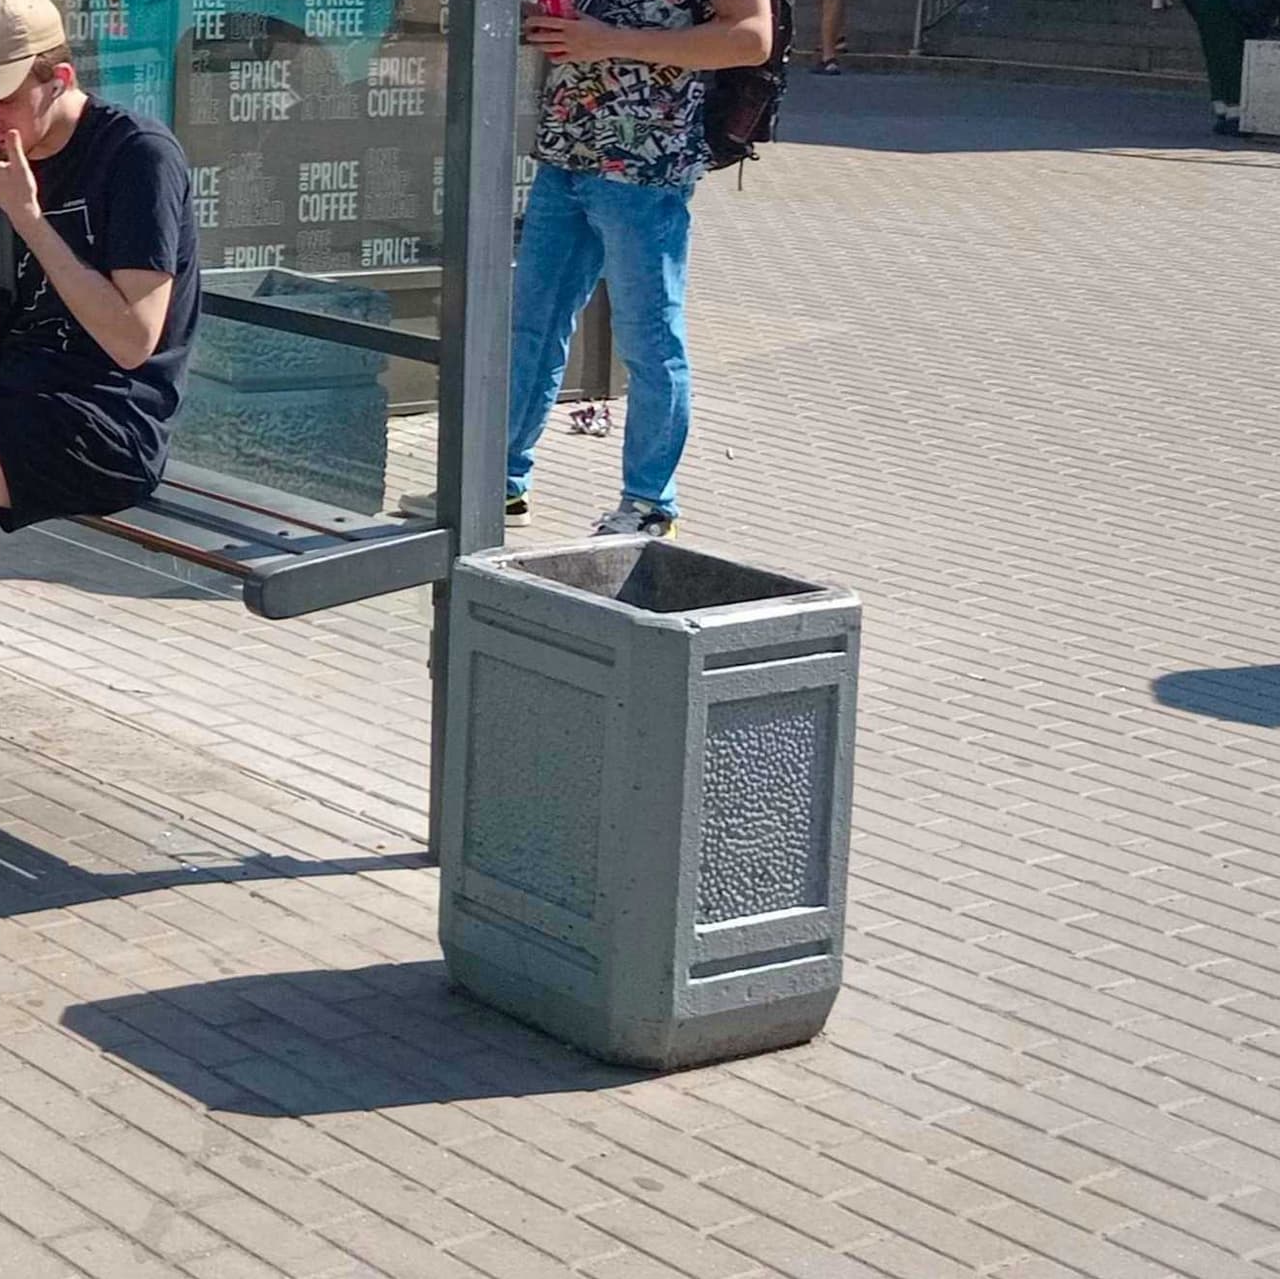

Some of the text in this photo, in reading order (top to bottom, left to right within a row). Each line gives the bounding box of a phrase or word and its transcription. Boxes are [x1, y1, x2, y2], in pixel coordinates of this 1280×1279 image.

[305, 8, 364, 38] COFFEE
[241, 59, 291, 90] PRICE
[378, 57, 426, 87] PRICE
[229, 91, 291, 122] COFFEE
[367, 88, 425, 118] COFFEE
[299, 160, 359, 191] ONE PRICE
[298, 192, 358, 223] COFFEE
[372, 236, 421, 266] PRICE
